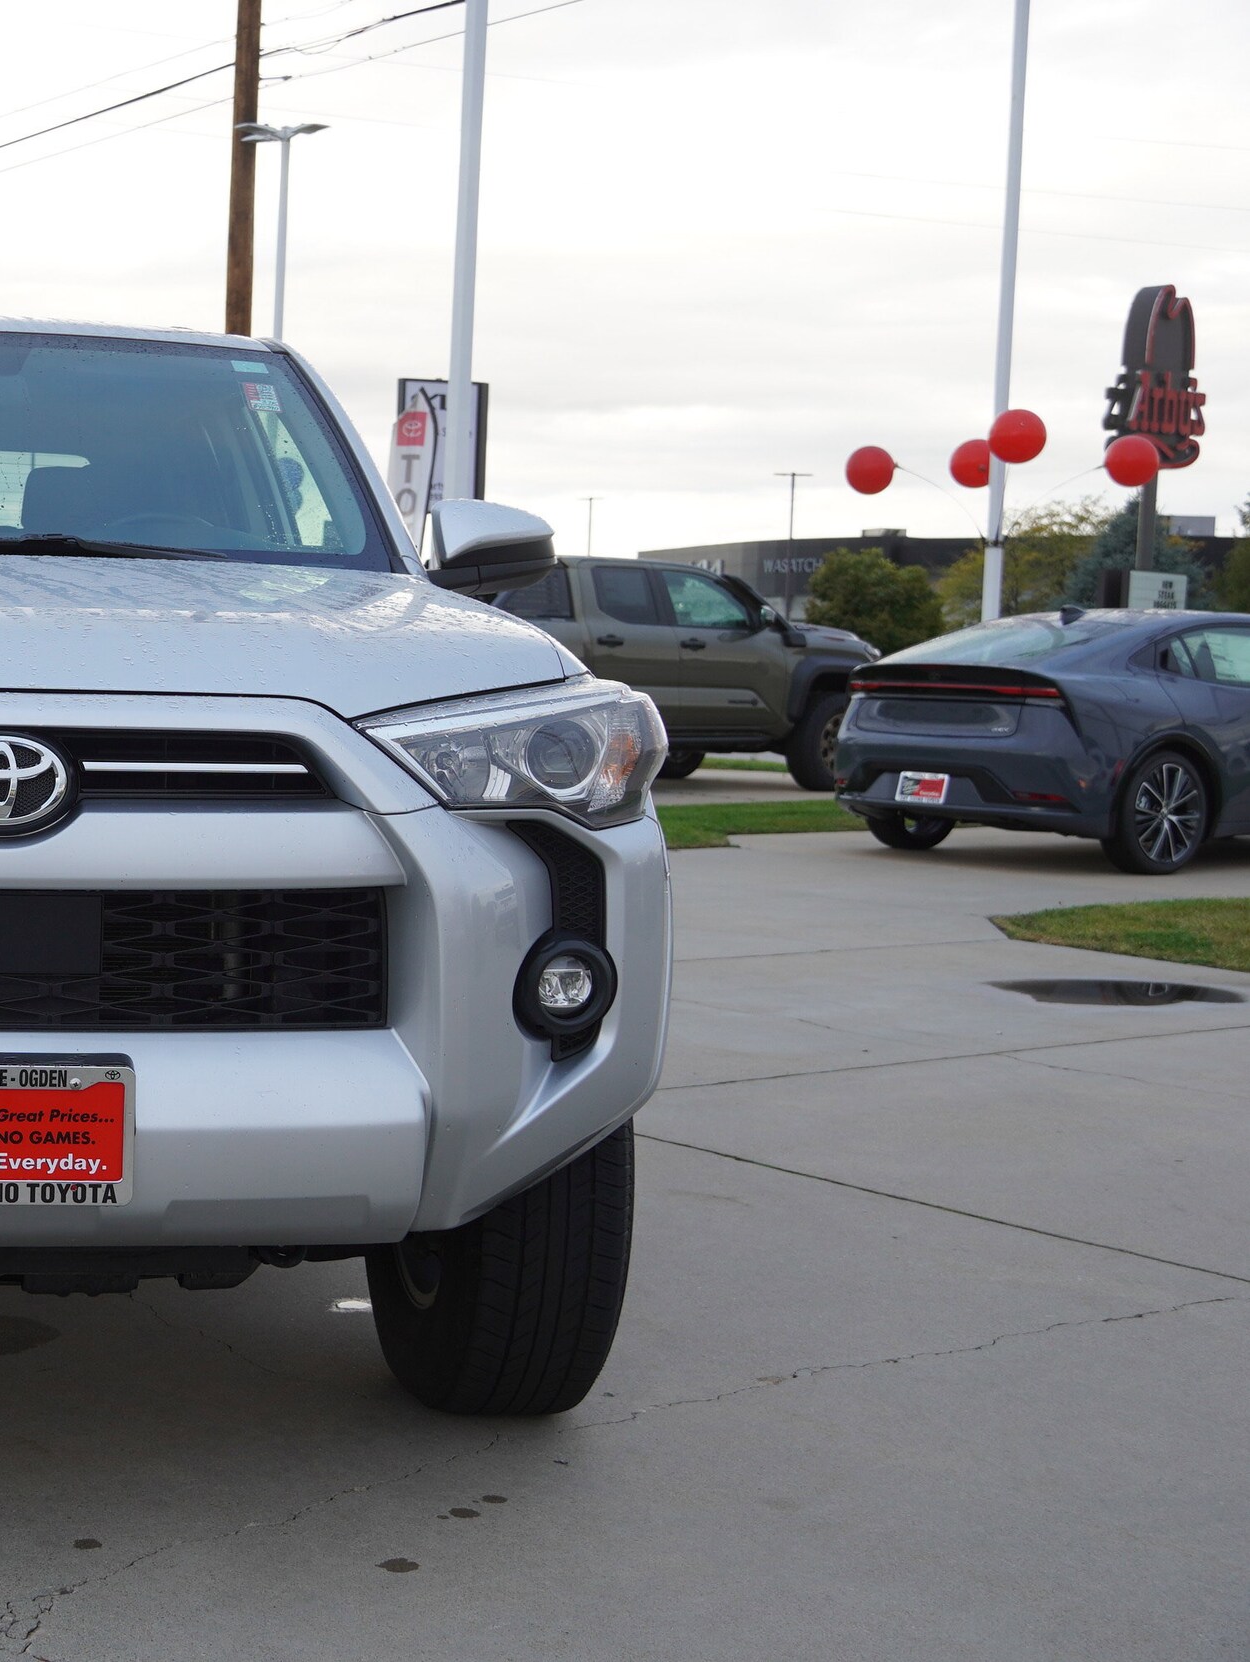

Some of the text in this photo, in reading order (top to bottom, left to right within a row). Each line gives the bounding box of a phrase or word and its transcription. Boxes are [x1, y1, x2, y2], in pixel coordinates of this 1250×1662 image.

[19, 1069, 67, 1088] OGDEN
[49, 1108, 114, 1123] Prices...
[29, 1130, 96, 1145] GAMES.
[26, 1182, 118, 1204] TOYOTA
